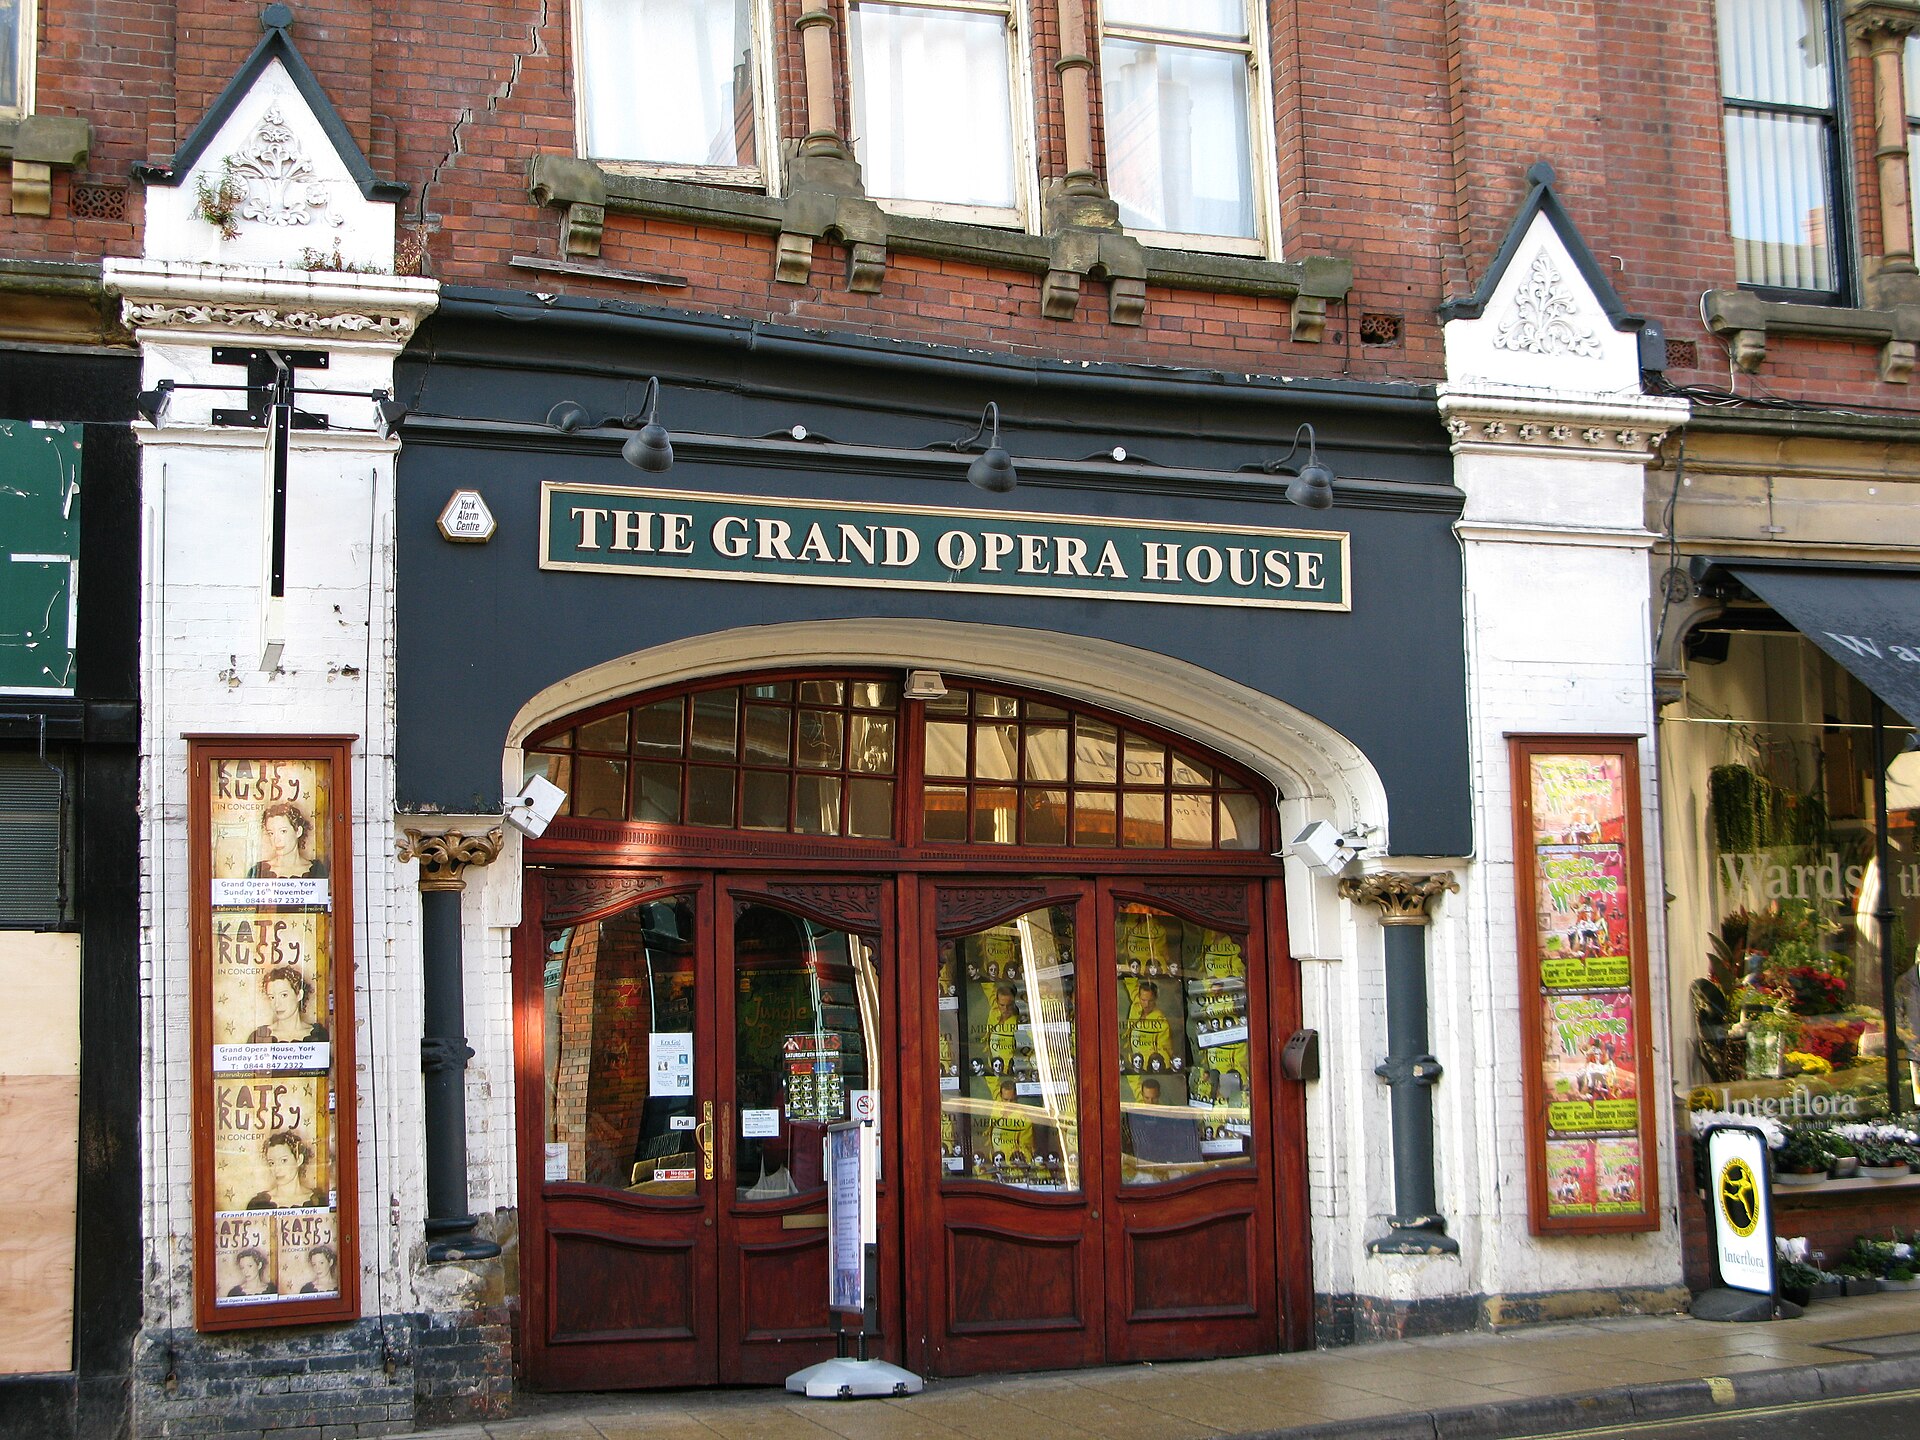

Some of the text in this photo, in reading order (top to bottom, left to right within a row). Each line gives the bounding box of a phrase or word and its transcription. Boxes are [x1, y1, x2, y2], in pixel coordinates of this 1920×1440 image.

[461, 500, 476, 510] York
[457, 510, 479, 520] Alarm
[456, 521, 480, 531] Centre
[570, 507, 1326, 590] THE GRAND OPERA HOUSE
[227, 803, 265, 811] CONCERT
[1720, 852, 1864, 900] Wards
[247, 881, 270, 889] Opera
[224, 889, 253, 897] Sunday
[971, 1024, 1018, 1034] MERCUR
[245, 1046, 268, 1054] Opera
[222, 1054, 252, 1062] Sunday
[1721, 1084, 1857, 1117] Interflora
[218, 1106, 301, 1130] RUSBY
[676, 1119, 690, 1127] Pull
[973, 1118, 1026, 1128] MERCURY
[227, 1133, 265, 1141] CONCERT
[215, 1220, 252, 1236] ATE
[215, 1233, 260, 1249] USBY
[1723, 1247, 1765, 1268] Interflora
